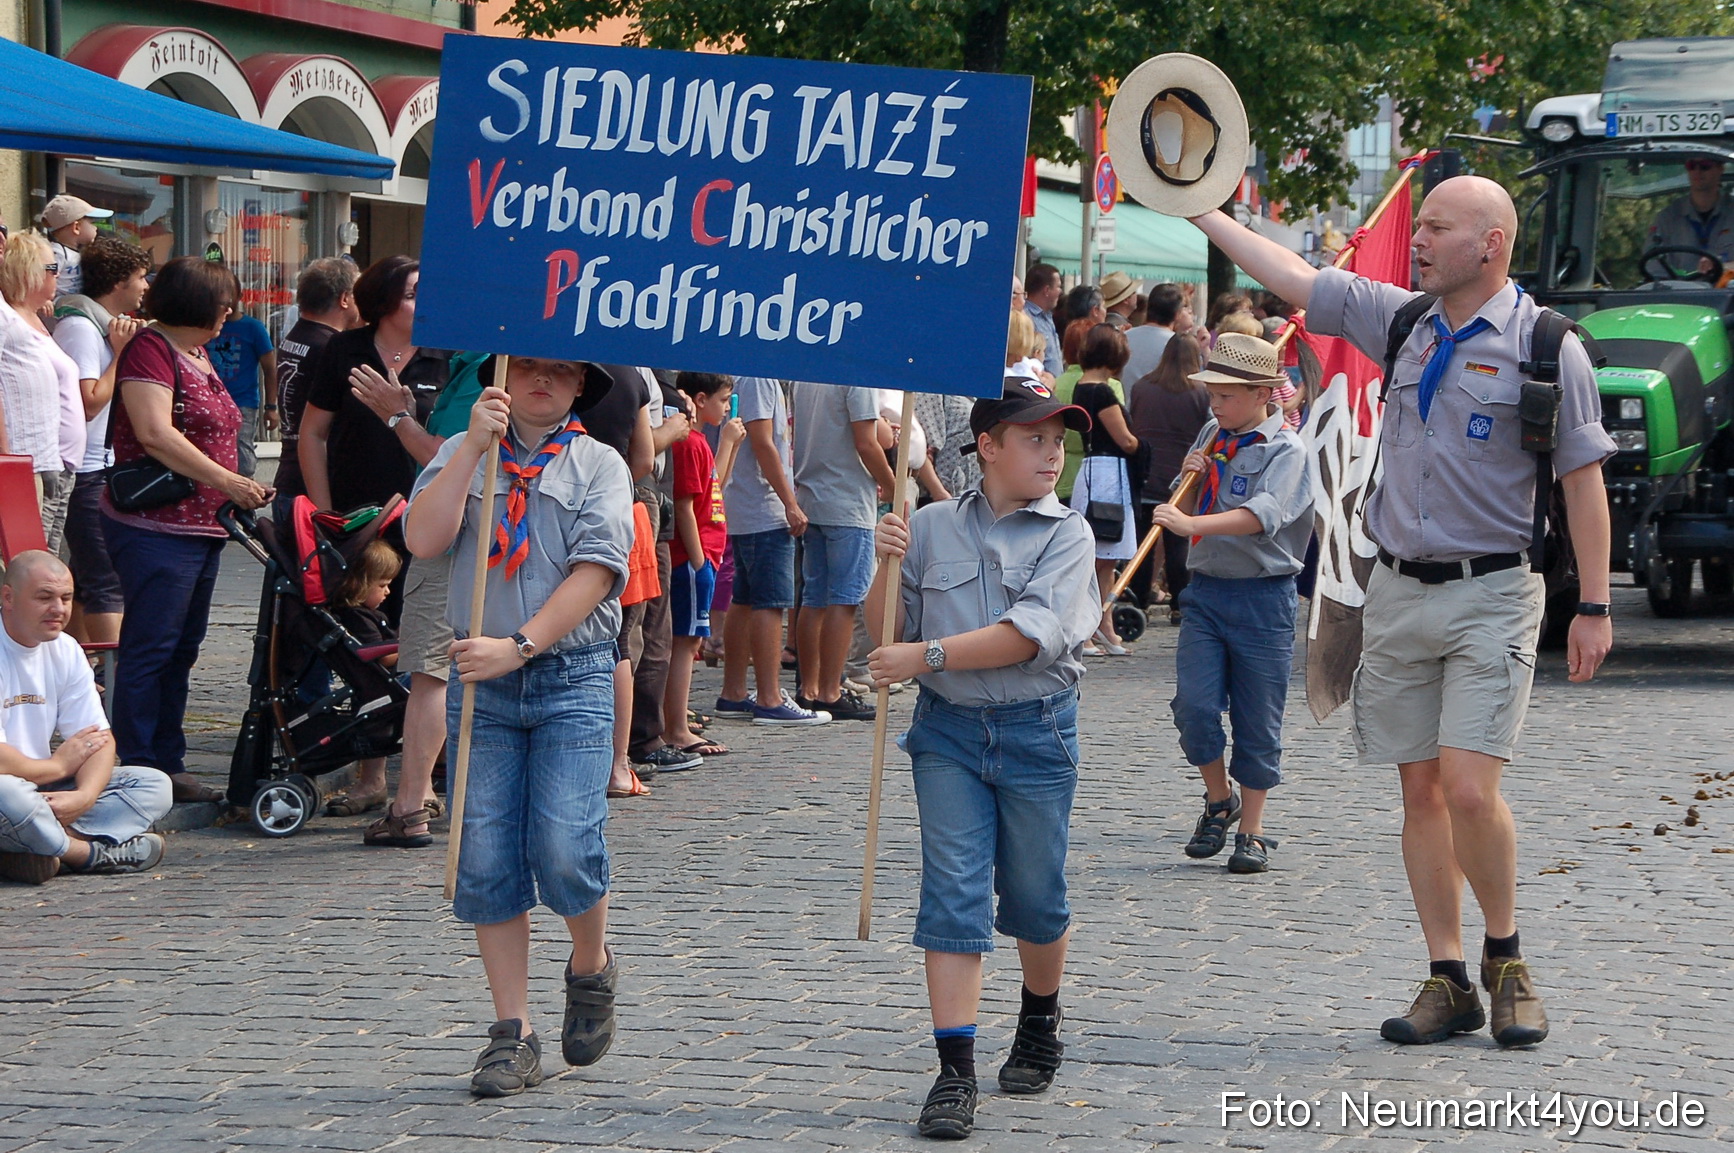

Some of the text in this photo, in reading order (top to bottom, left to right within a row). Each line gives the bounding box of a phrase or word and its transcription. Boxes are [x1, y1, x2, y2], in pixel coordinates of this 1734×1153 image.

[290, 65, 364, 109] Metzgerei
[479, 59, 969, 179] SIEDLUNG TAIZÉ
[1656, 114, 1680, 132] TS
[1686, 113, 1721, 131] 329
[468, 156, 989, 268] Verband Christlicher
[543, 249, 863, 346] Pfadfinder
